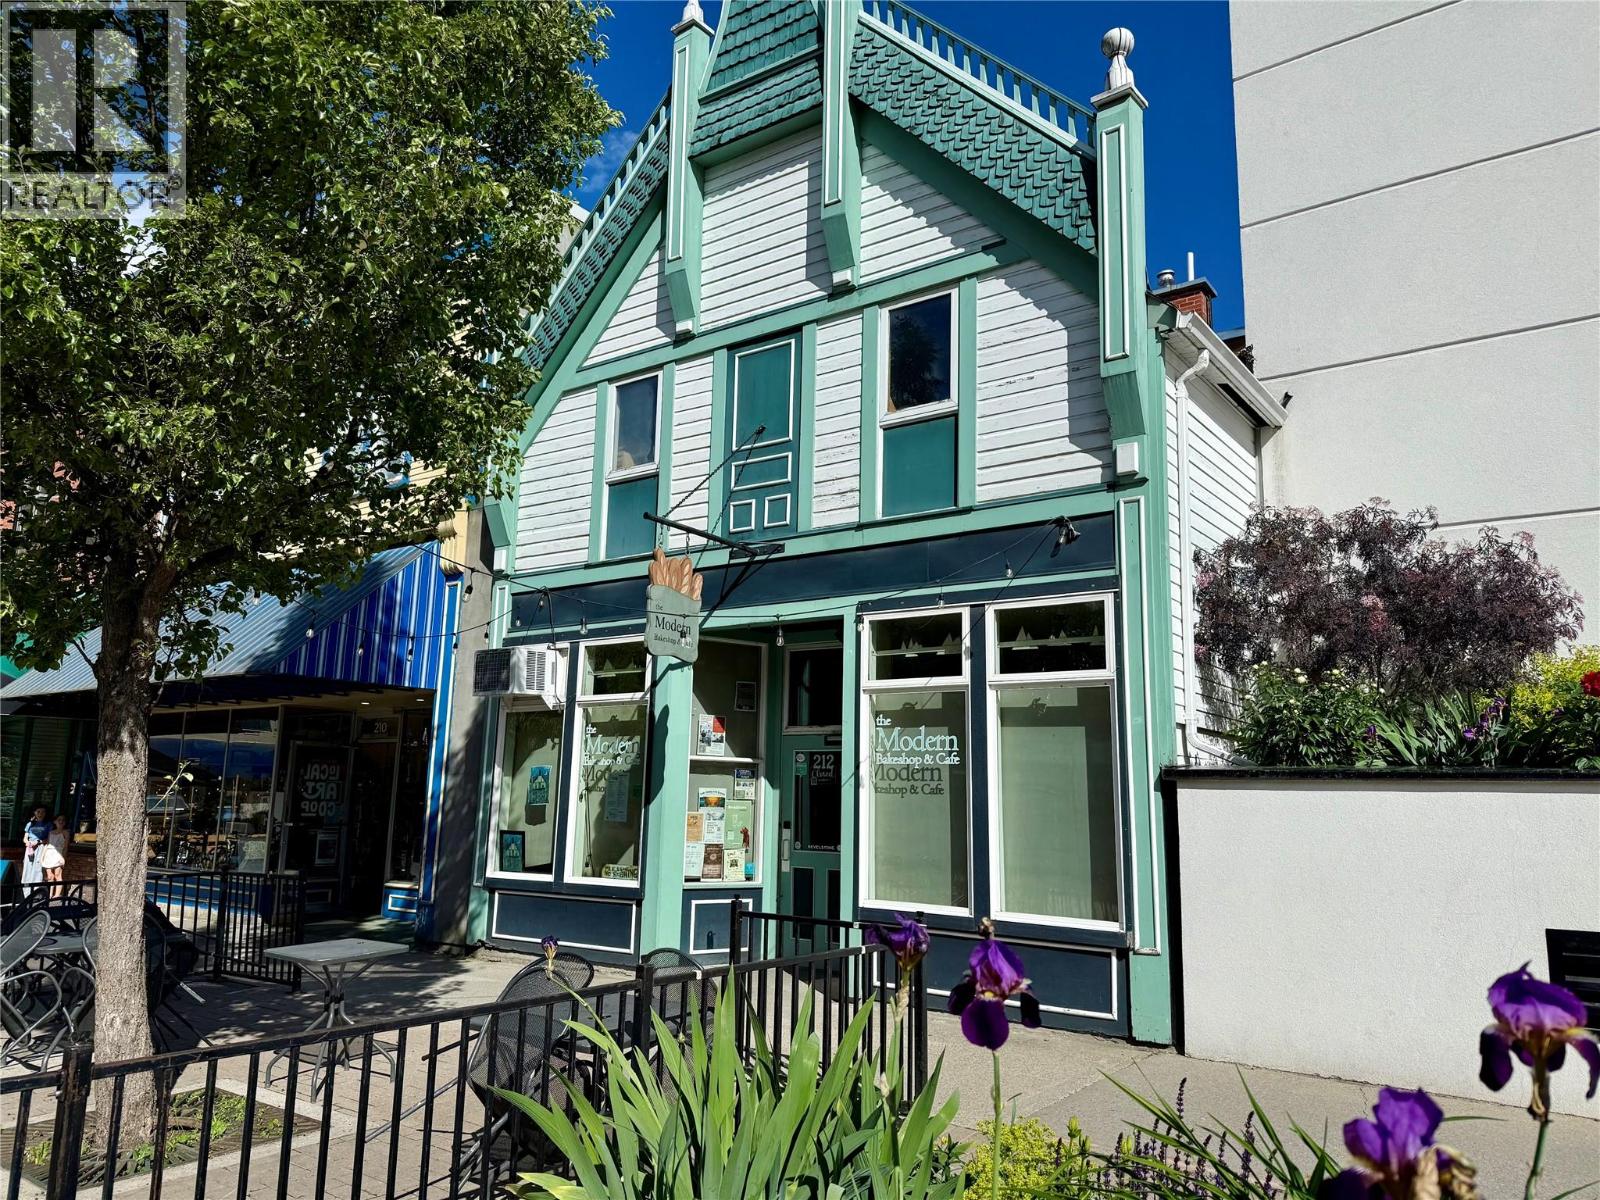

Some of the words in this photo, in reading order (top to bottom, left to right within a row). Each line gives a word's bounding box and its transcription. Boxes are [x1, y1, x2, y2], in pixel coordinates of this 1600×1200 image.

[876, 713, 892, 726] the
[586, 723, 598, 734] the
[585, 734, 641, 755] Modern
[876, 725, 960, 752] Modern
[813, 754, 835, 769] 212
[876, 752, 922, 769] Bakeshop
[923, 753, 935, 765] &
[936, 752, 961, 765] Cafe
